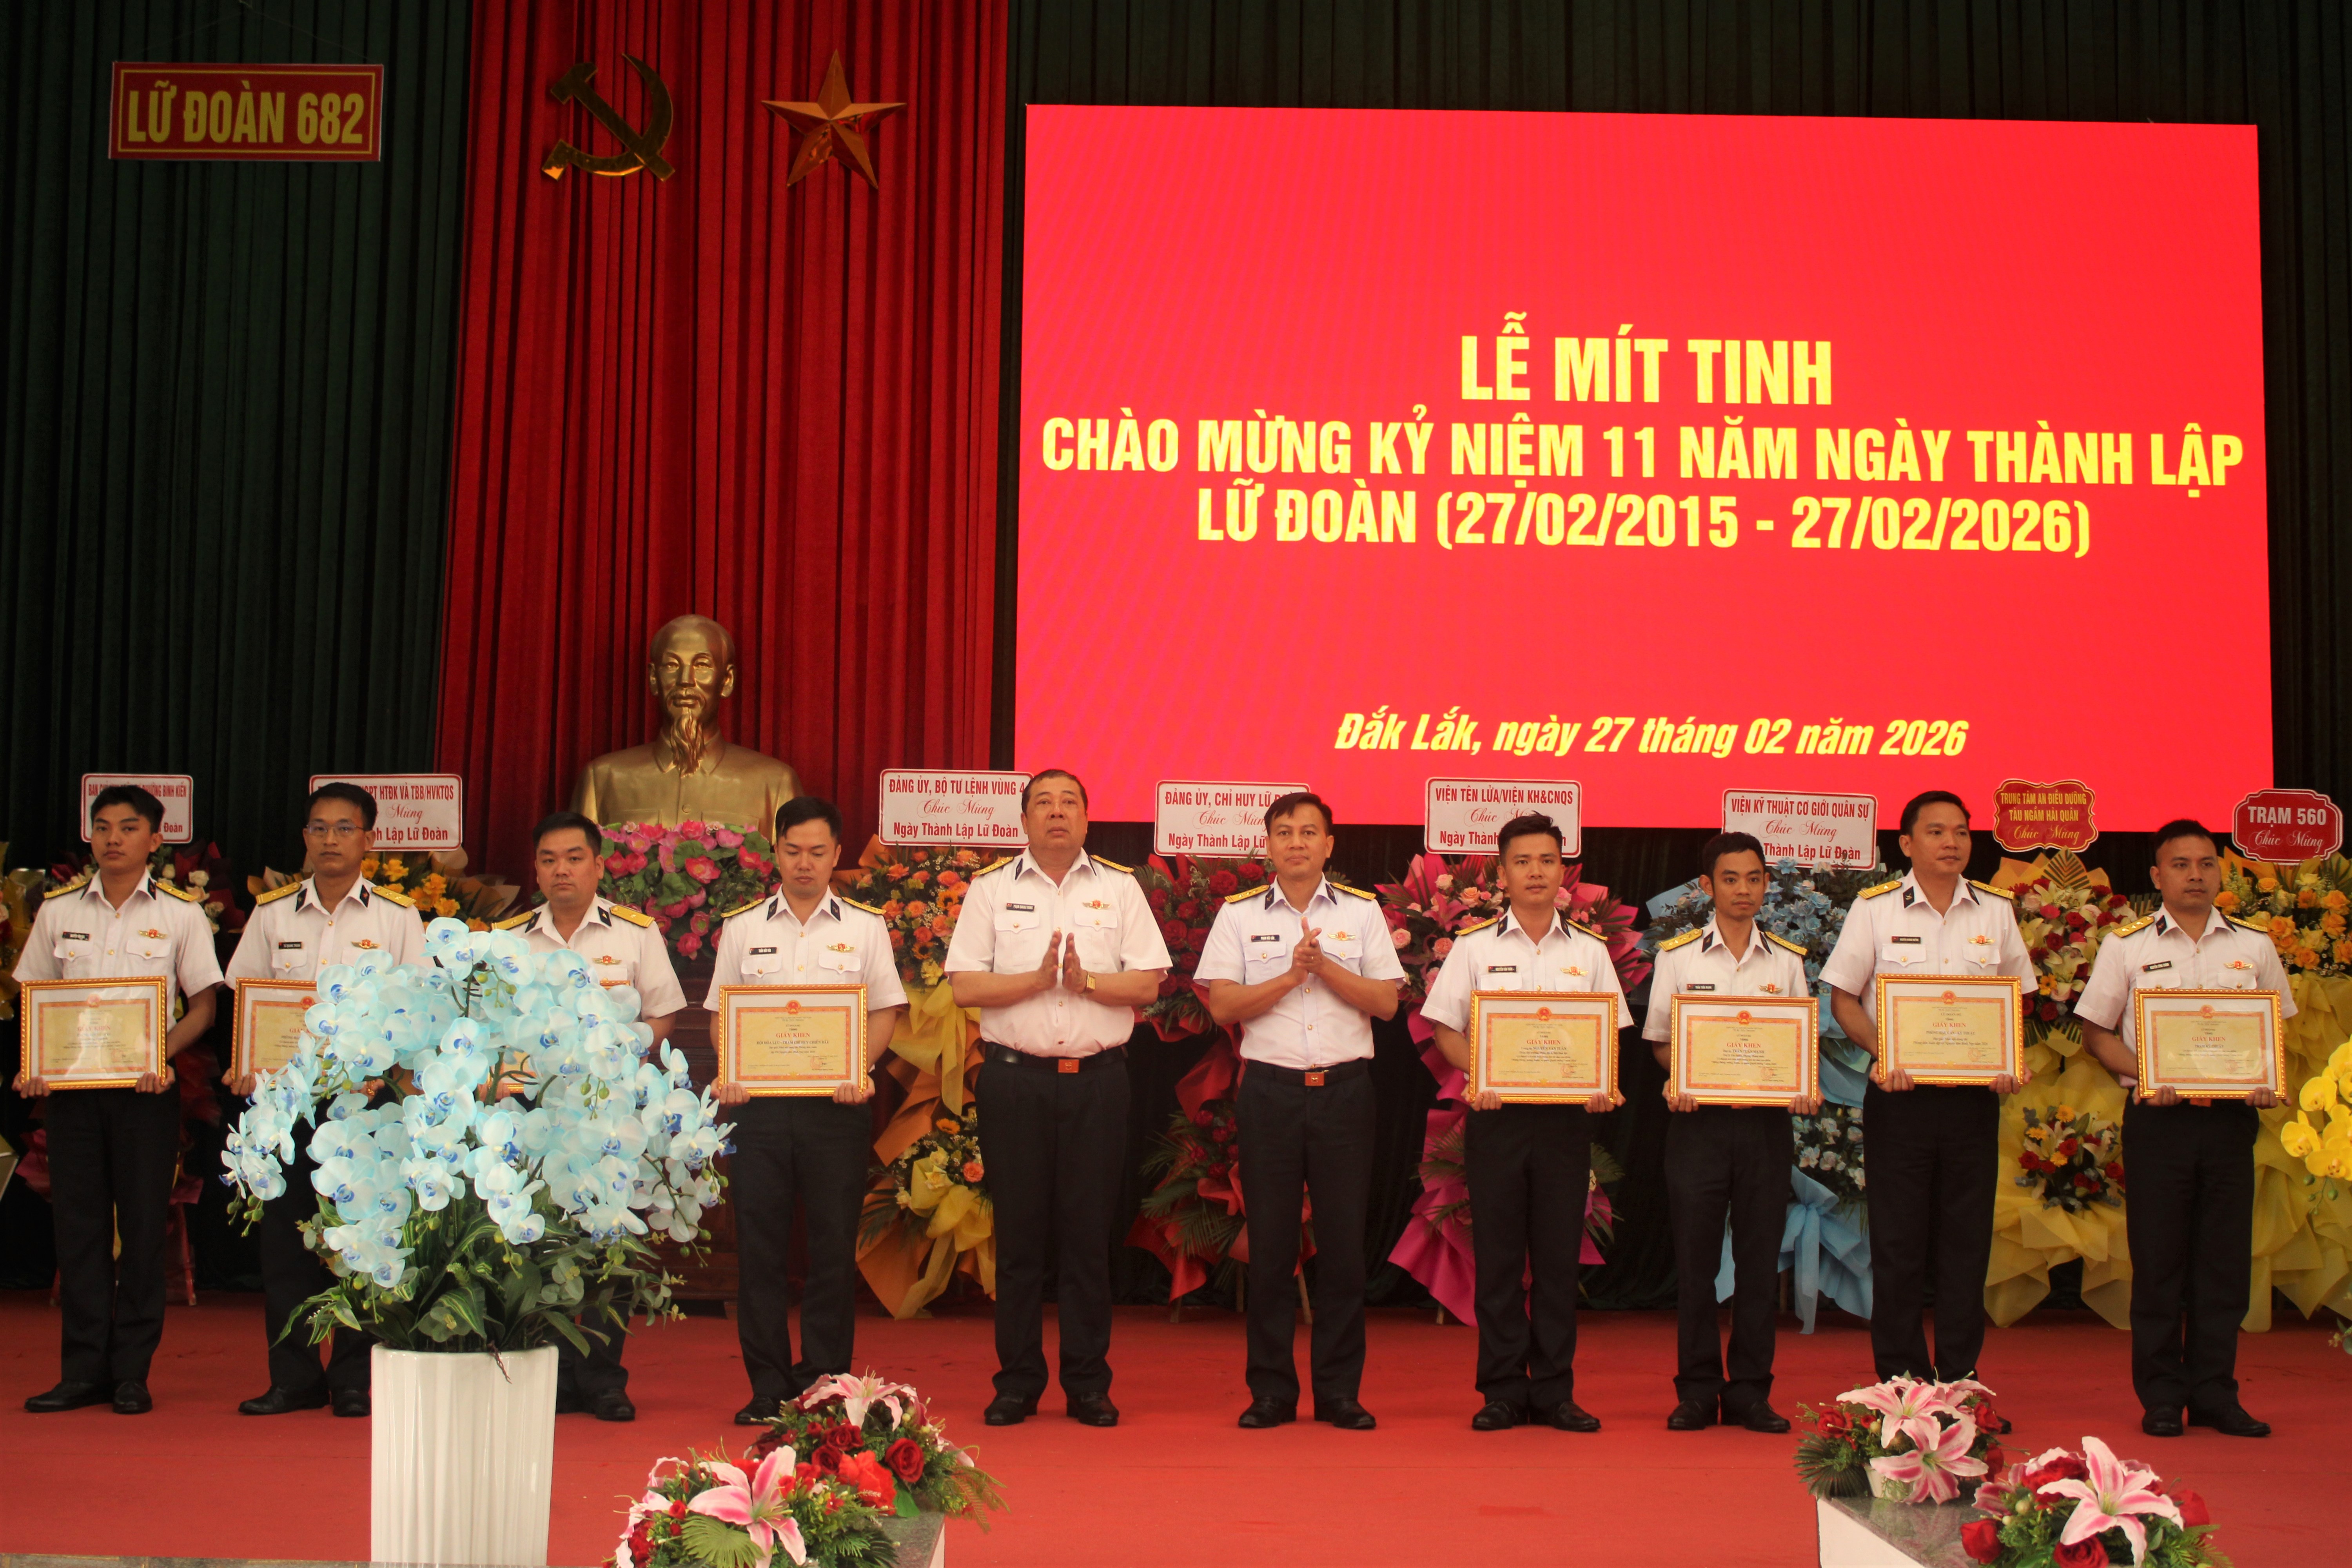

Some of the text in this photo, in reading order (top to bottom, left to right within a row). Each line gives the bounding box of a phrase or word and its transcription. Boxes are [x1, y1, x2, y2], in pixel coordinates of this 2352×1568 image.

[127, 80, 364, 144] LỮ ĐOÀN 682
[1461, 311, 1832, 405] LỄ MÍT TINH
[1042, 404, 2243, 498] CHÀO MỪNG KỶ NIỆM 11 NĂM NGÀY THÀNH LẬP
[1198, 477, 2090, 558] LỮ ĐOÀN (27/02/2015 - 27/02/2026)
[1334, 705, 1969, 758] Đắk Lắk, ngày 27 tháng 02 năm 2026
[163, 783, 174, 797] BÌNH
[380, 785, 397, 800] HTĐK
[400, 782, 409, 800] VÀ
[411, 785, 454, 801] TBB/HVKTQS
[889, 775, 1025, 798] ĐẢNG ỦY, BỘ TƯ LỆNH VÙNG 4
[1436, 785, 1573, 806] VIỆN TÊN LỬA/VIỆN KH&CNQS
[2001, 789, 2087, 804] TRUNG TÂM AN ĐIỀU DƯỠNG
[1165, 788, 1192, 806] ĐẢNG
[1196, 788, 1211, 808] ỦY,
[1215, 789, 1232, 806] CHỈ
[1236, 793, 1256, 807] HUY
[1259, 791, 1272, 807] LỮ
[386, 802, 424, 824] Mừng
[917, 799, 995, 820] Chúc Mừng
[1464, 808, 1499, 827] Chúc
[1731, 796, 1870, 821] VIỆN KỸ THUẬT CƠ GIỚI QUÂN SỰ
[2009, 806, 2078, 822] TÀU NGẦM HẢI QUÂN
[2248, 806, 2326, 827] TRẠM 560
[164, 822, 183, 833] Đoàn
[1193, 810, 1229, 829] Chúc
[386, 827, 404, 844] Lập
[408, 827, 419, 840] Lữ
[422, 827, 448, 840] Đoàn
[894, 822, 1018, 839] Ngày Thành Lập Lữ Đoàn
[1440, 831, 1499, 847] Ngày Thành
[1759, 820, 1838, 842] Chúc Mừng
[2010, 825, 2080, 845] Chúc Mừng
[1169, 833, 1194, 849] Ngày
[1197, 833, 1228, 848] Thành
[1232, 835, 1250, 851] Lập
[1764, 843, 1860, 860] Thành Lập Lữ Đoàn
[2249, 830, 2323, 853] Chúc Mừng
